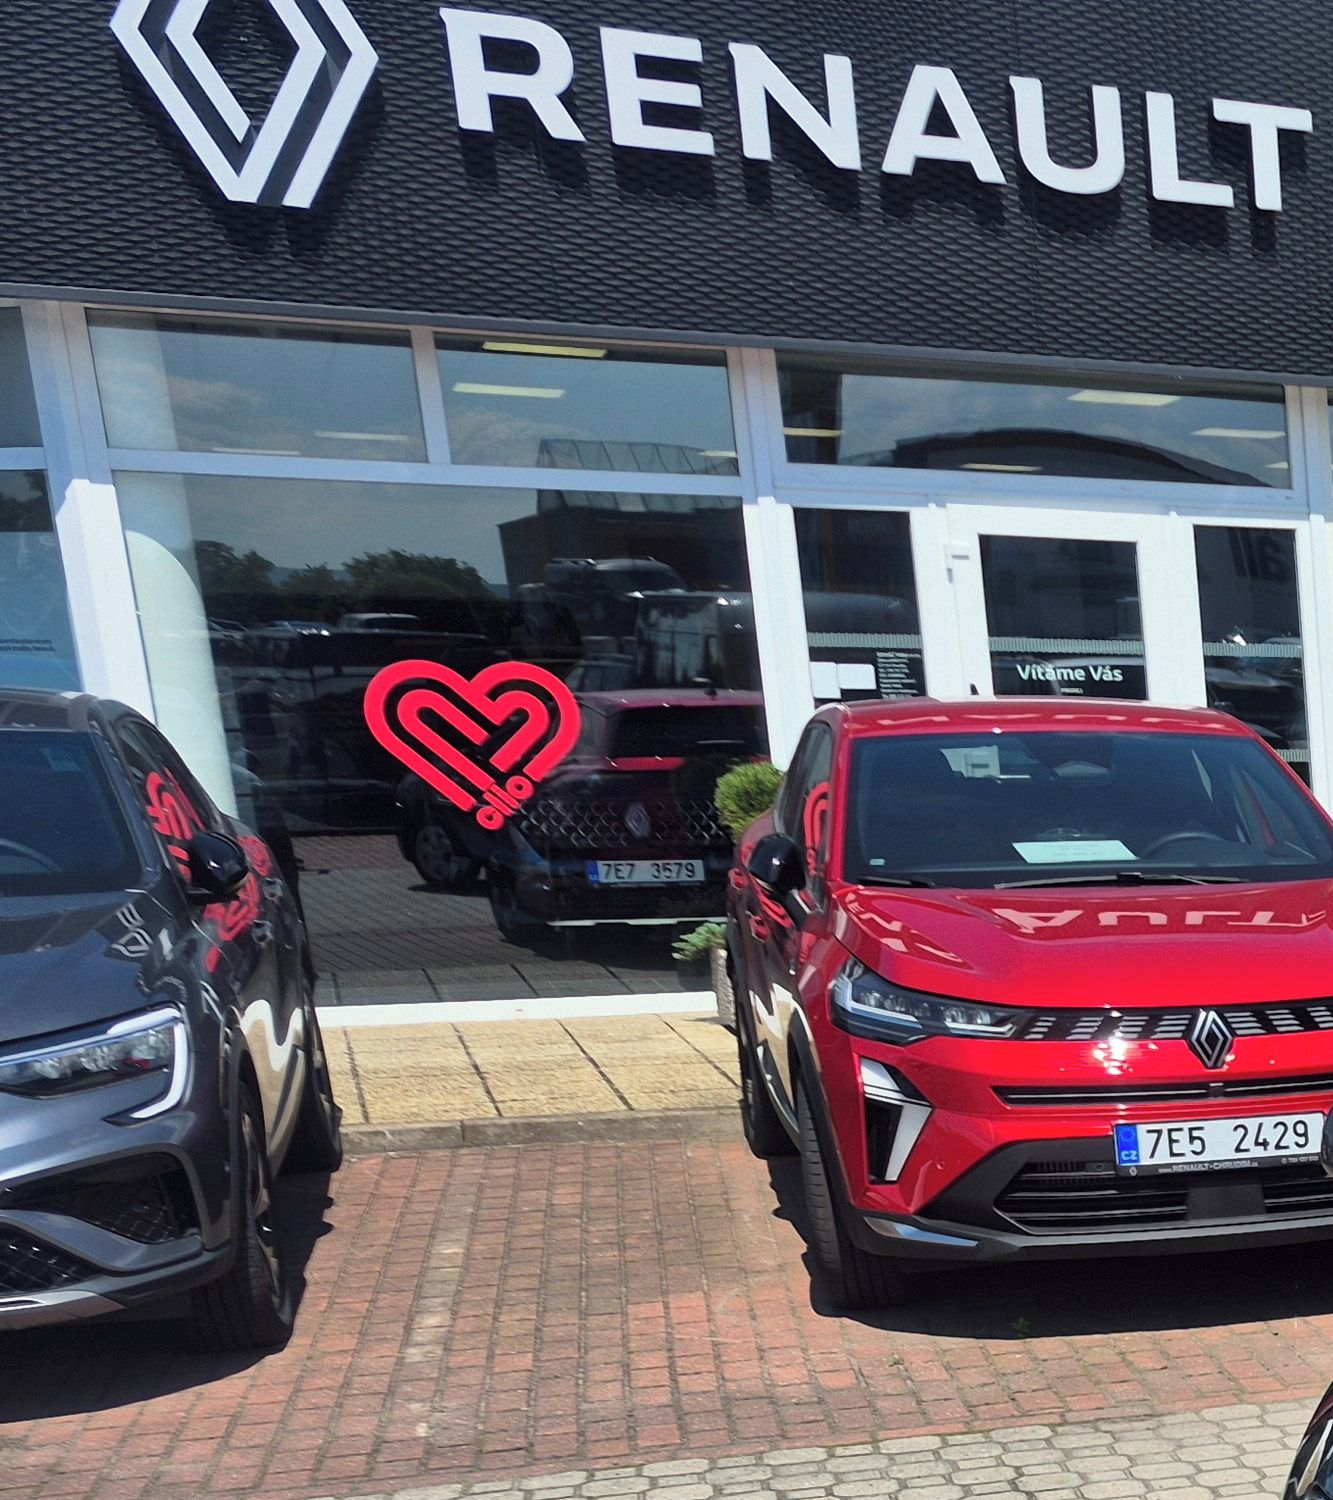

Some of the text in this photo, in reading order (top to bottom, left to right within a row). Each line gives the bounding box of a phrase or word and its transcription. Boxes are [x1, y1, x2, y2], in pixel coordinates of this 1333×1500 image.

[439, 7, 1314, 213] RENAULT
[1016, 663, 1124, 681] Vítáme Vás
[602, 863, 635, 880] 7E7
[651, 862, 696, 879] 3579
[1146, 1119, 1310, 1160] 7E5 2429
[1121, 1150, 1139, 1161] CZ
